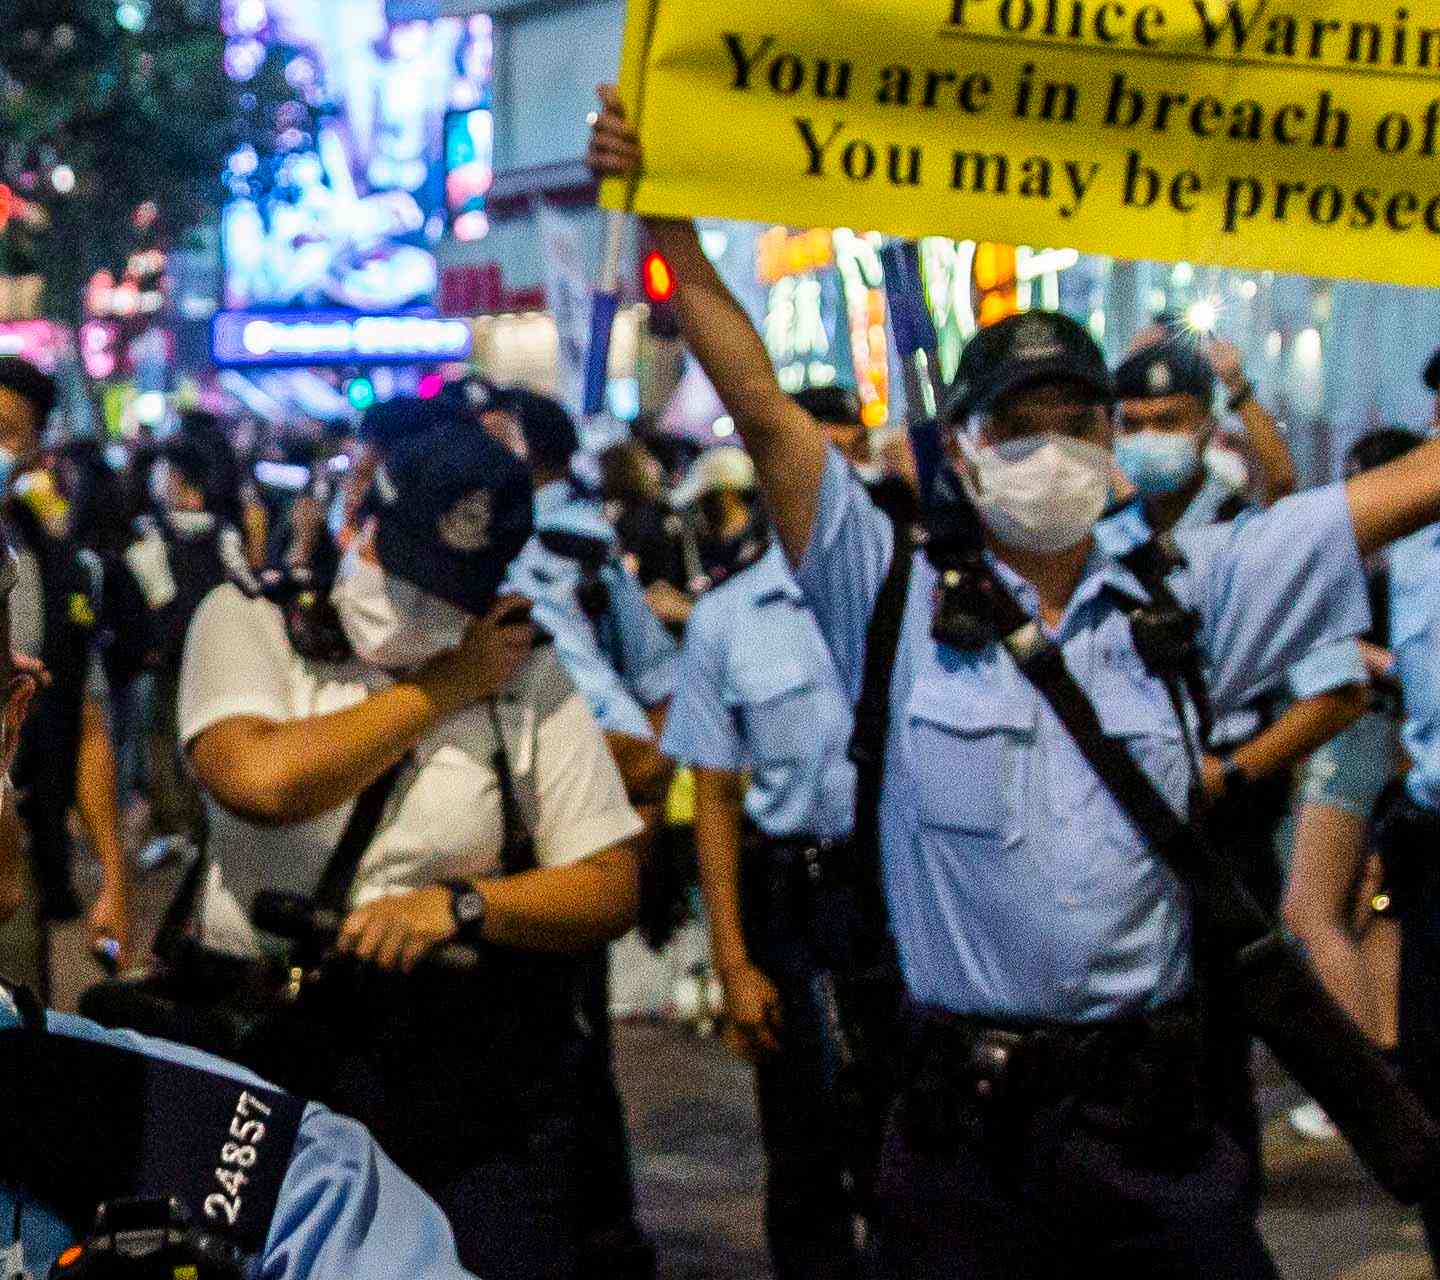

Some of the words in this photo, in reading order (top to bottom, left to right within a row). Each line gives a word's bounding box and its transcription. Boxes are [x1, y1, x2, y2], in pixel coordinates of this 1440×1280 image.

[721, 31, 853, 101] You
[875, 66, 993, 115] are
[1016, 62, 1079, 122] in
[1102, 72, 1351, 151] breach
[793, 117, 923, 187] You
[950, 148, 1101, 218] may
[1122, 149, 1202, 213] be
[203, 1089, 272, 1225] 24857
